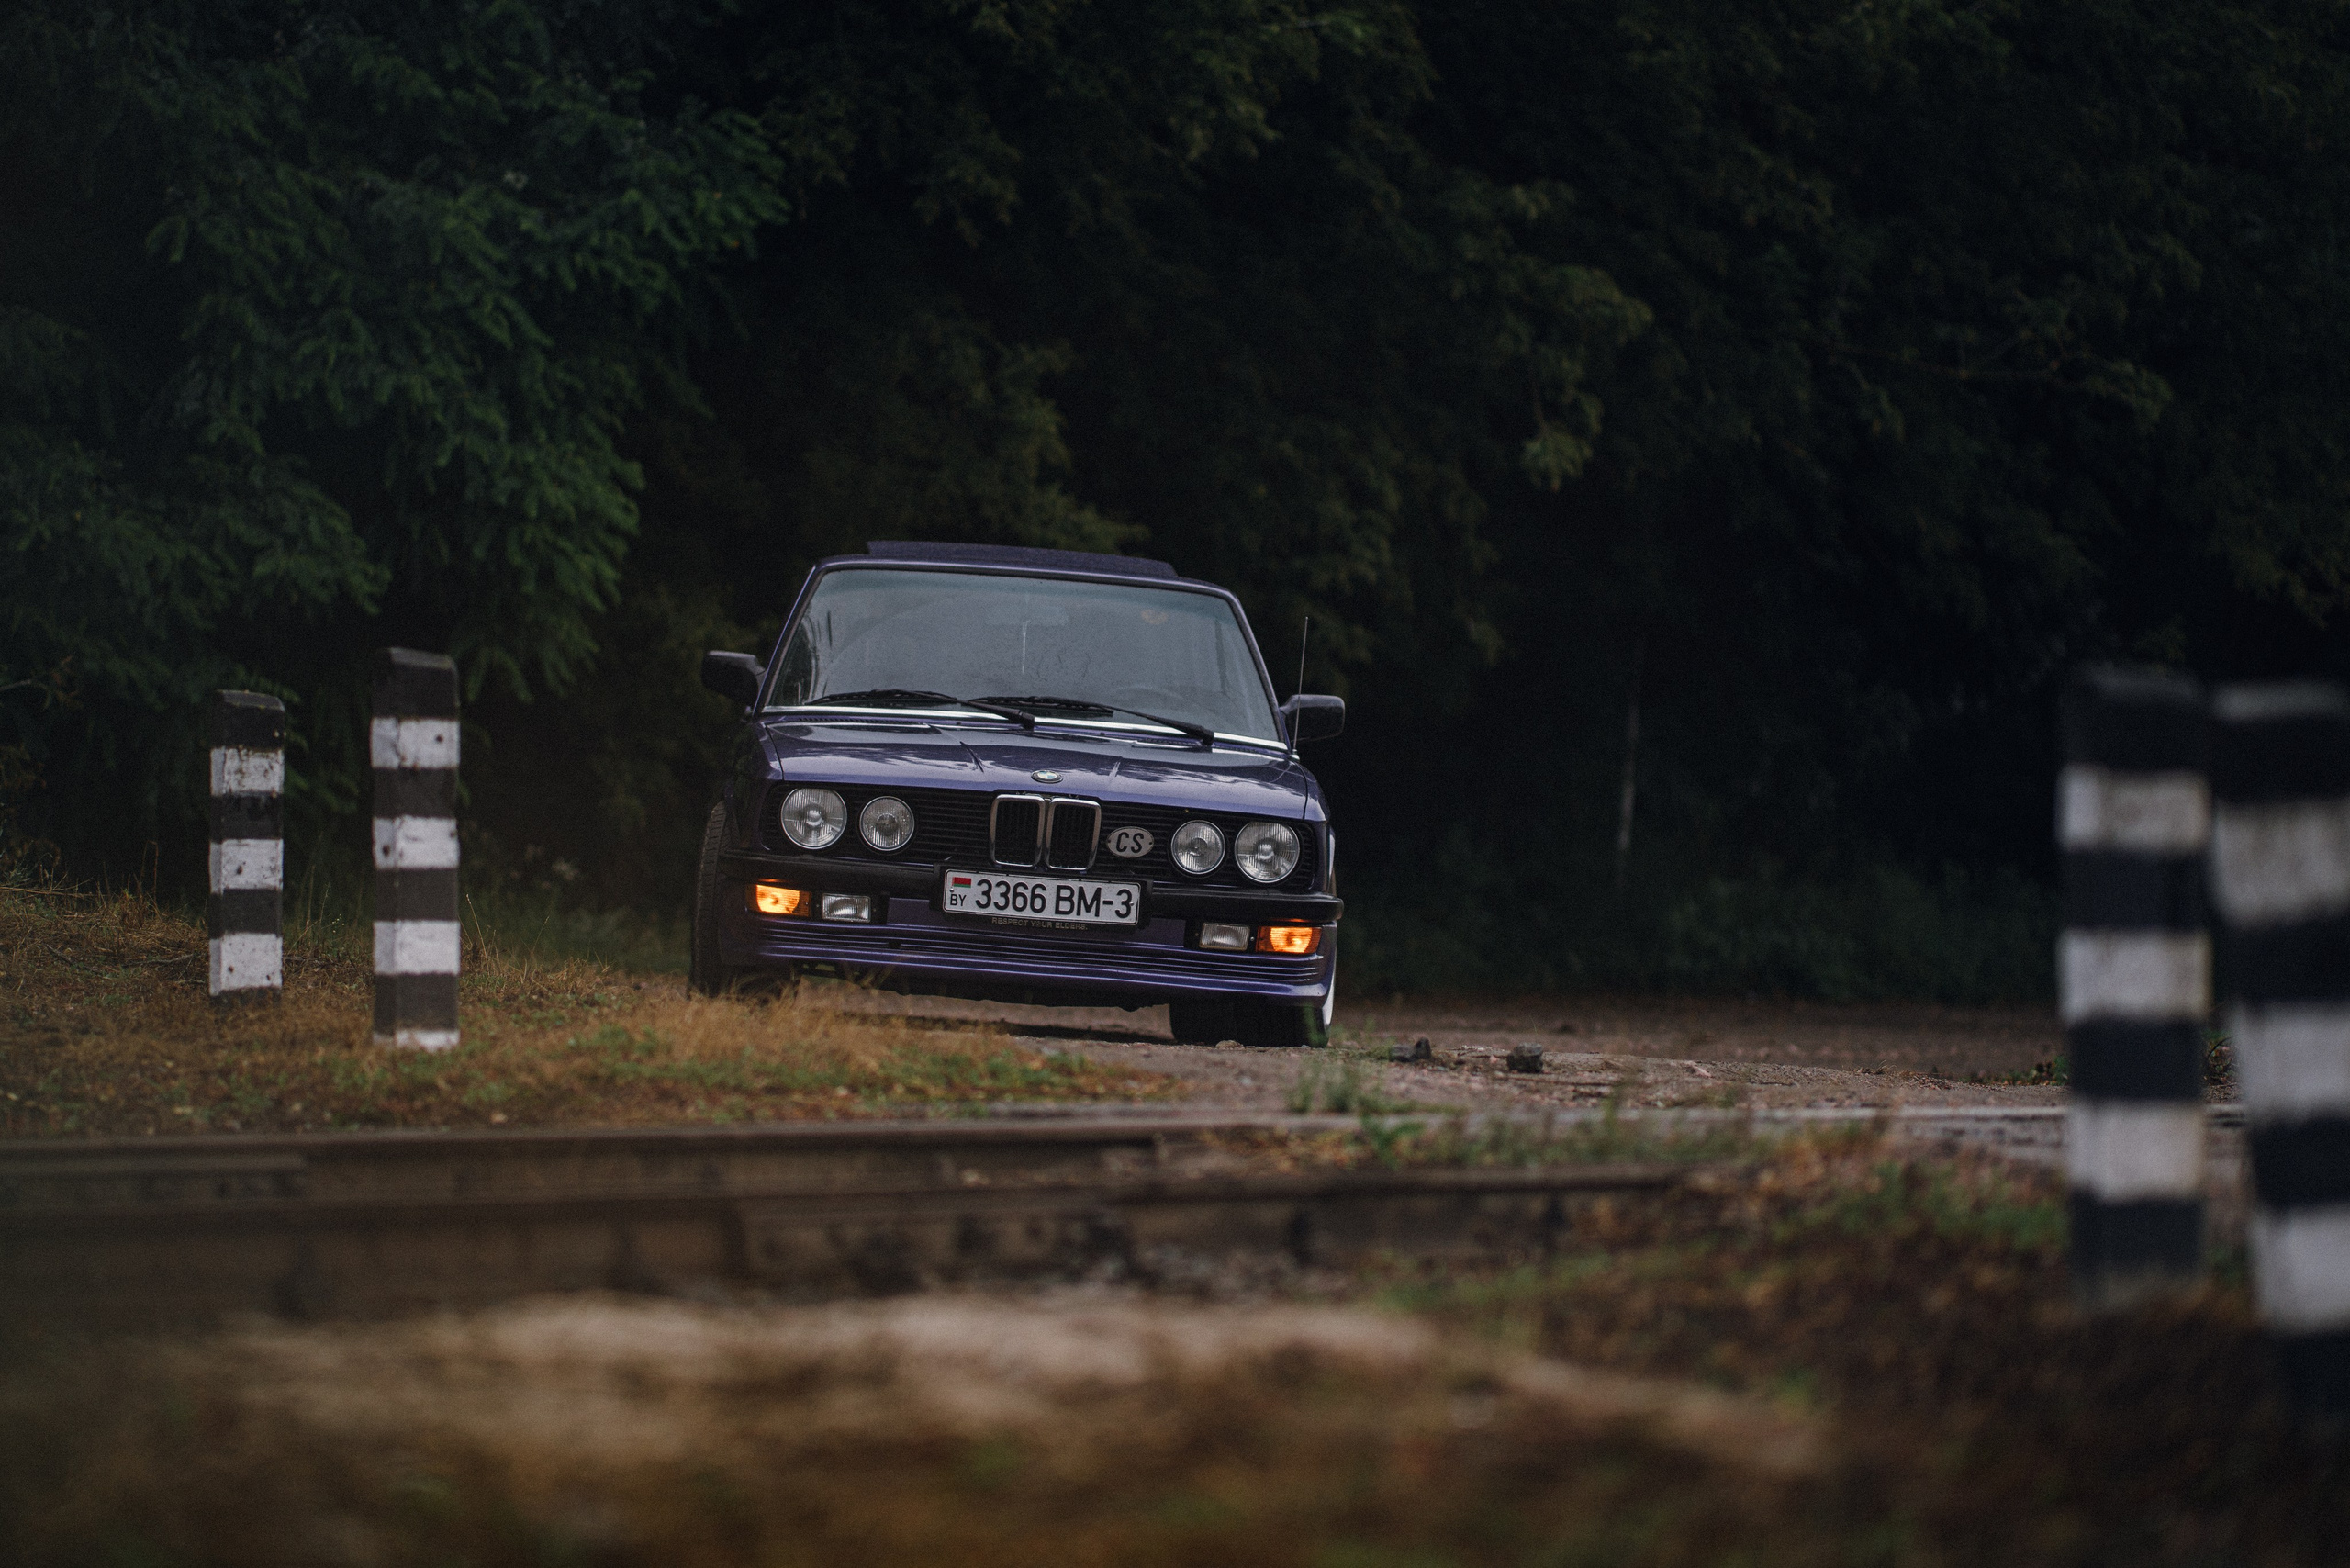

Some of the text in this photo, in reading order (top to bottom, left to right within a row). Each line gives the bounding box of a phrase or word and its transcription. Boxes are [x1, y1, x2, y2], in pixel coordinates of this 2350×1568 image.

[1115, 831, 1144, 853] CS
[949, 893, 967, 907] BY
[975, 879, 1132, 918] 3366 BM-3
[991, 917, 1029, 927] RESPECT
